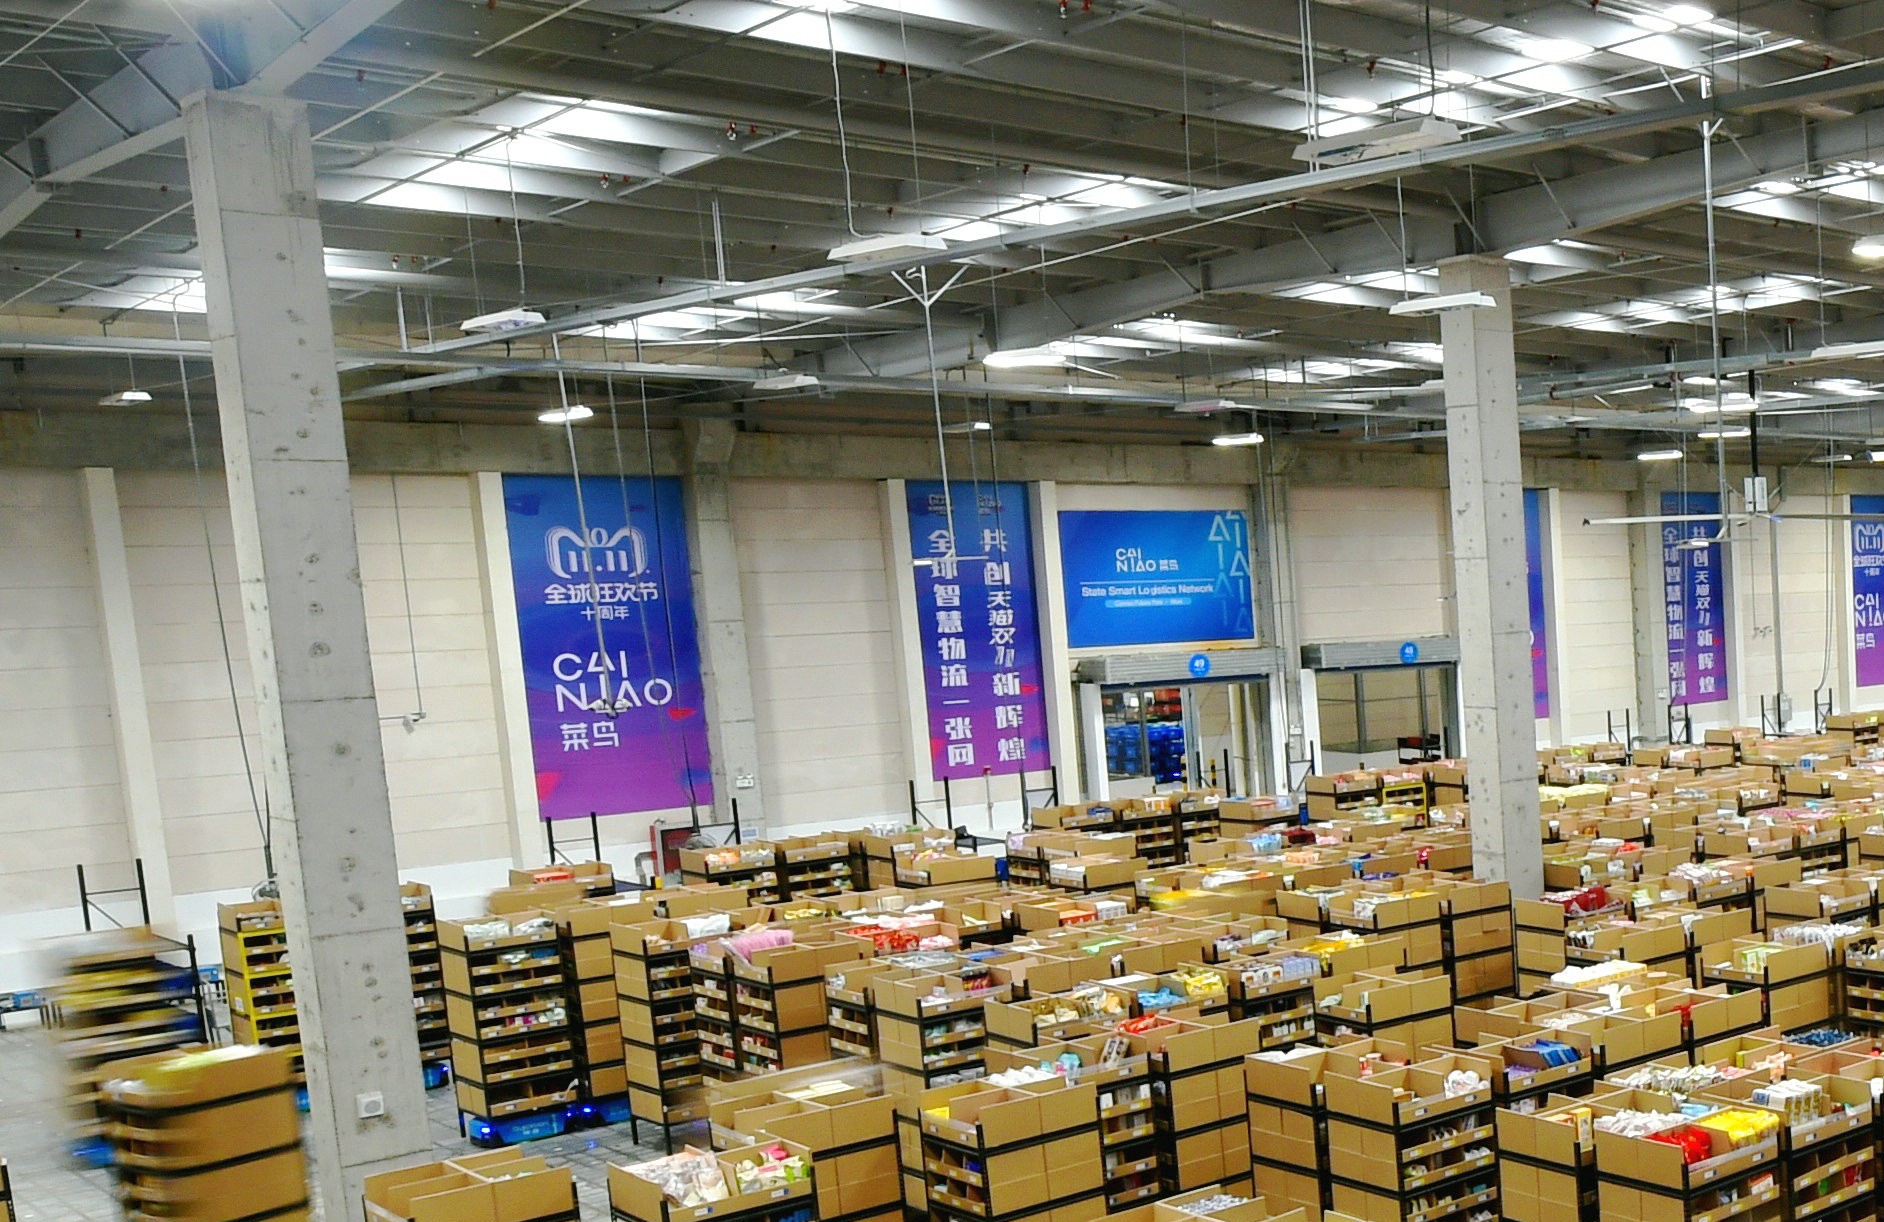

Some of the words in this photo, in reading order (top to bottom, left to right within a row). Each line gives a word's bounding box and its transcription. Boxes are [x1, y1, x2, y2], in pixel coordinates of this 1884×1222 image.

[567, 550, 629, 574] 11.11
[544, 581, 659, 605] 全球狂欢节
[1108, 585, 1136, 596] Smart
[1178, 583, 1214, 594] Network
[1854, 592, 1880, 611] CAI
[580, 605, 630, 621] 十周年
[928, 529, 975, 767] 全球智慧物流一张网
[980, 528, 1027, 762] 共创天猫双11新辉煌
[552, 650, 628, 682] CAI
[554, 677, 673, 713] NIAO
[560, 720, 620, 752] 菜鸟
